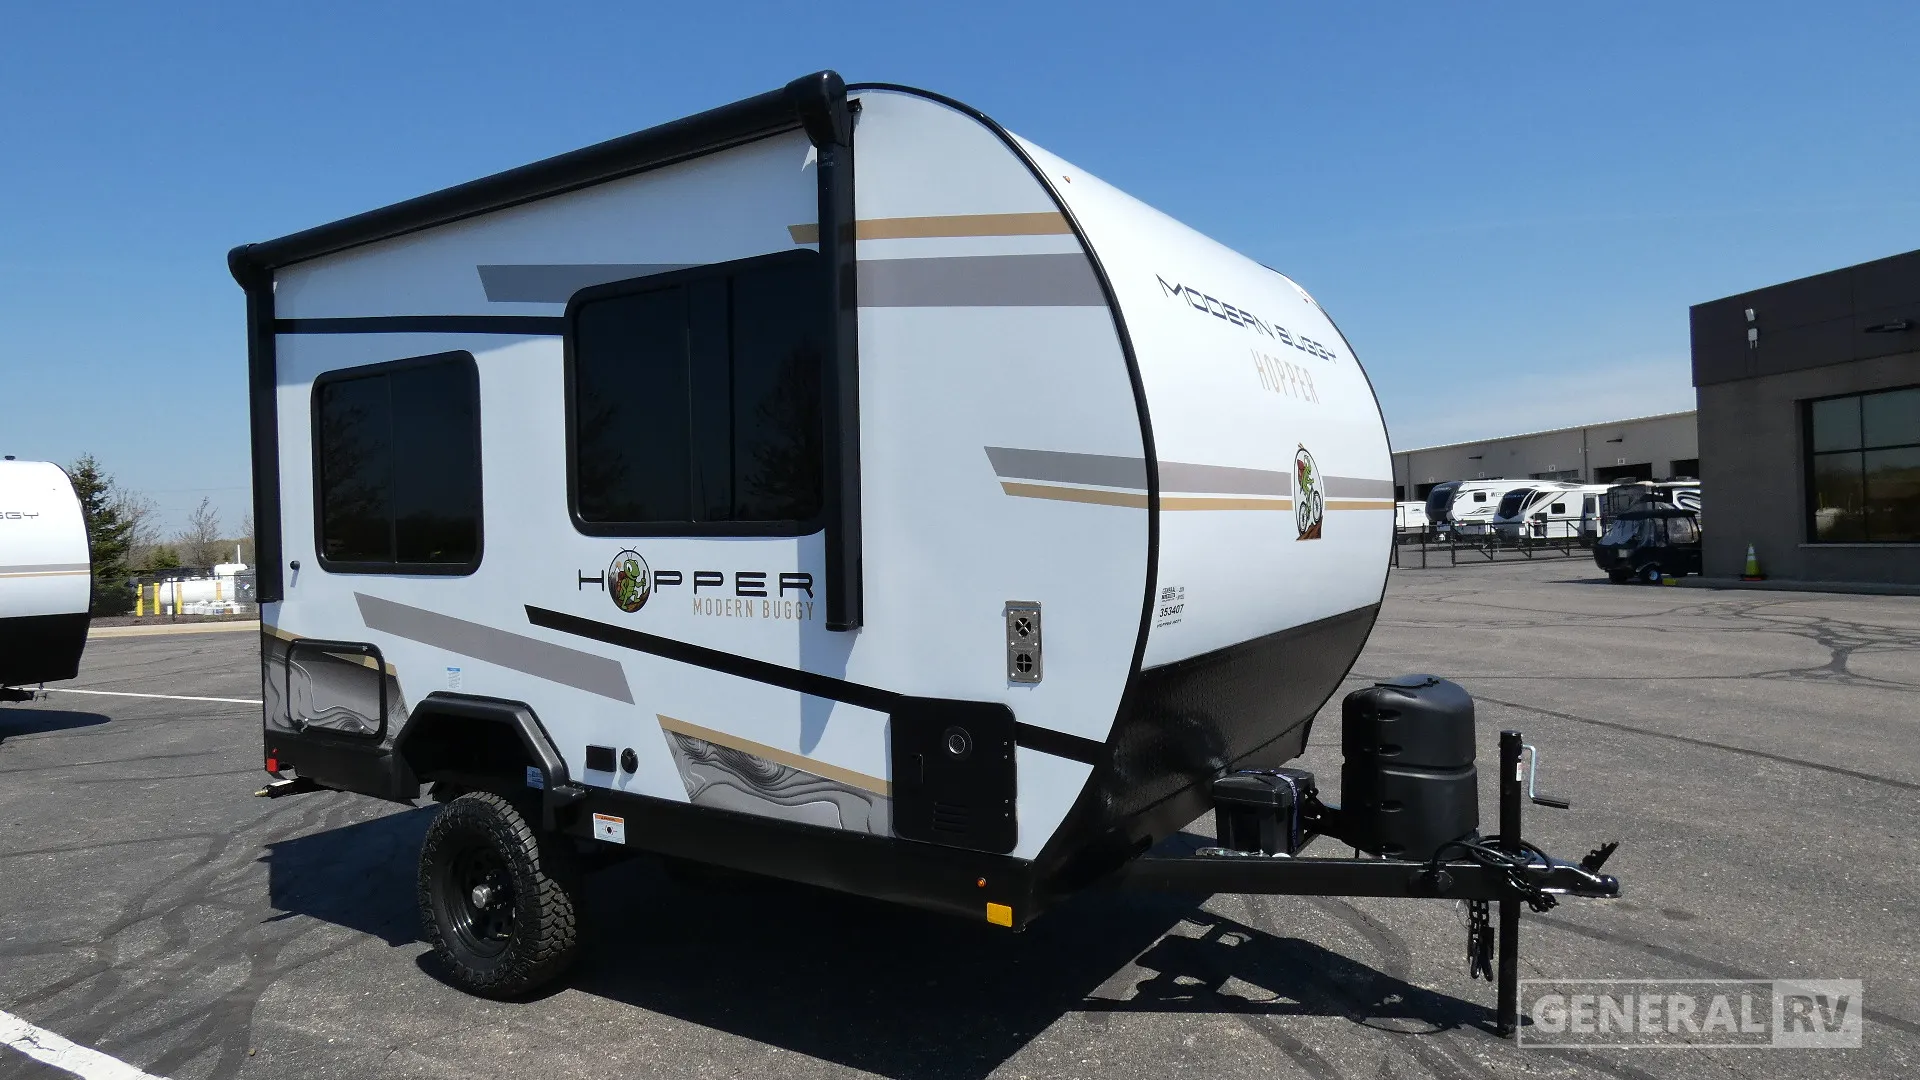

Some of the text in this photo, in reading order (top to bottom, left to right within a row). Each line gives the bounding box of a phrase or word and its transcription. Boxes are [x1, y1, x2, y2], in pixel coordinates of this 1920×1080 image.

[1155, 273, 1337, 364] MODERN BUGGY
[1250, 348, 1319, 405] HOPPER
[0, 511, 39, 520] GY
[693, 597, 814, 620] MODERN BUGGY
[1159, 603, 1185, 618] 353407
